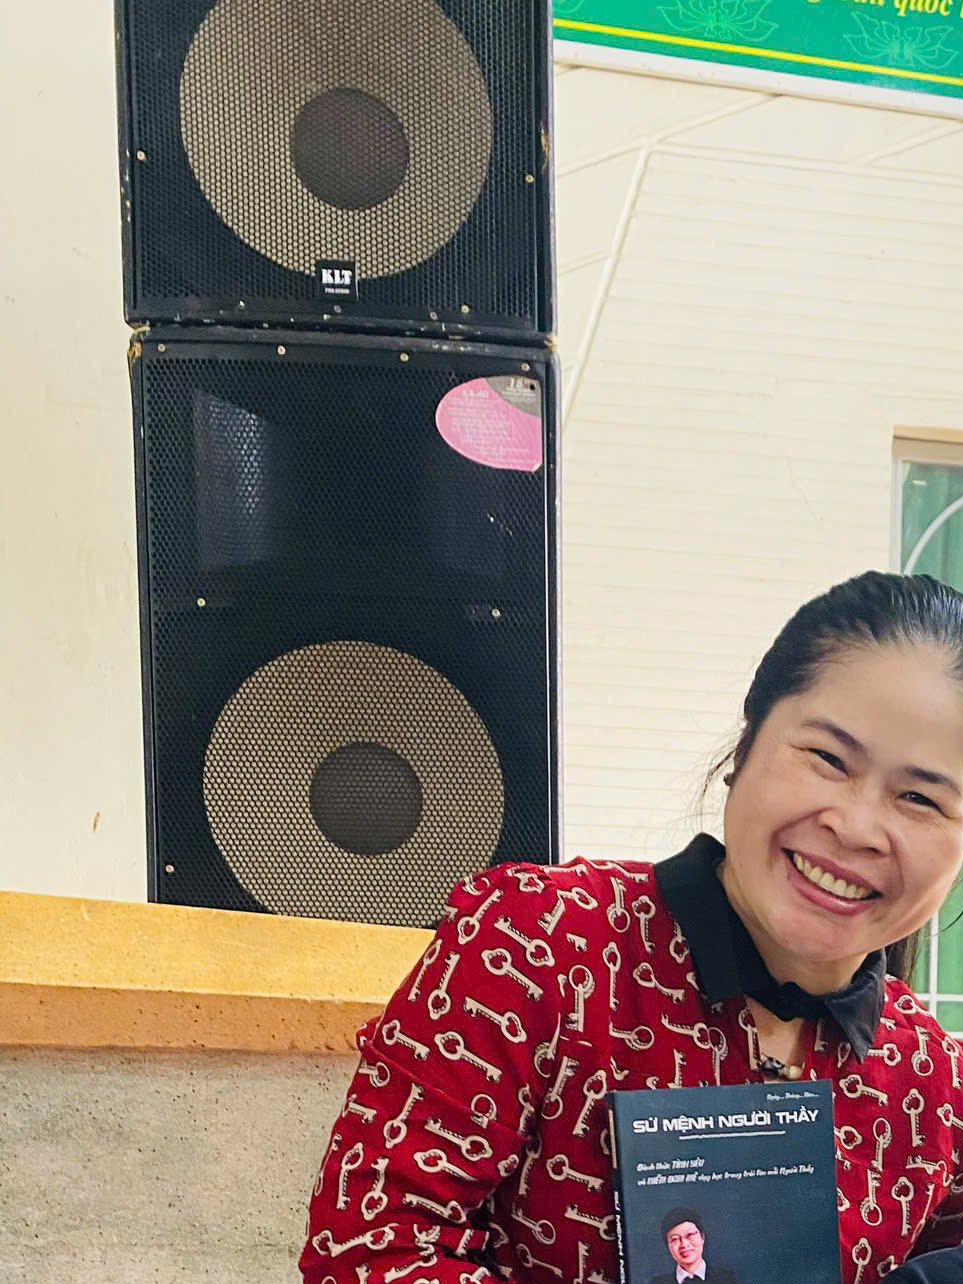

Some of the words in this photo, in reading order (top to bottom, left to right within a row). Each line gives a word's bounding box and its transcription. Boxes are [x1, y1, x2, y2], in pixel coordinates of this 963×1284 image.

[321, 269, 352, 285] KLT
[633, 1117, 658, 1133] SỨ
[663, 1116, 714, 1132] MỆNH
[718, 1111, 770, 1127] NGƯỜI
[775, 1108, 818, 1124] THẦY
